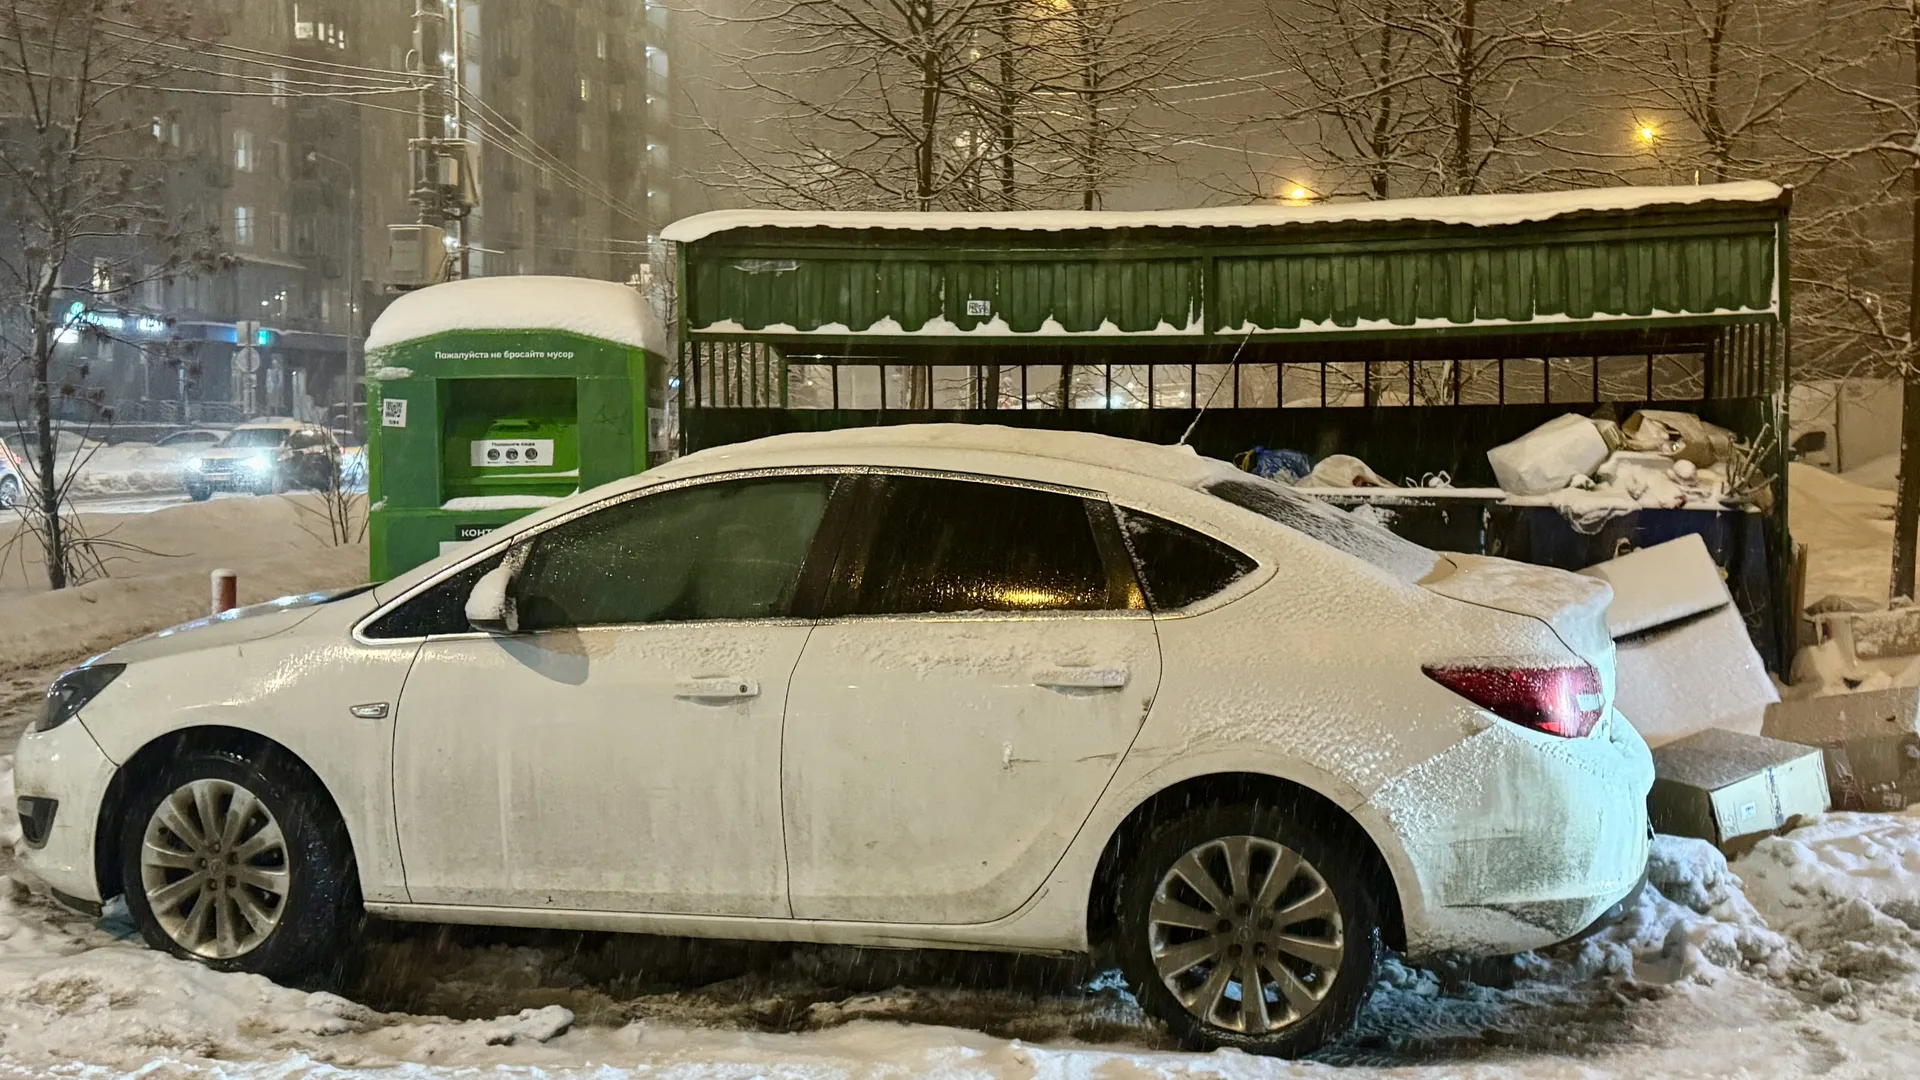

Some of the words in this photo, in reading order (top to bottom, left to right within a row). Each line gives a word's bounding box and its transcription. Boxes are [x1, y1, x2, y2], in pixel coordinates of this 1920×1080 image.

[434, 351, 489, 361] Пожалуйста
[490, 351, 502, 359] не
[503, 350, 545, 360] бросайте
[546, 351, 574, 360] мусор
